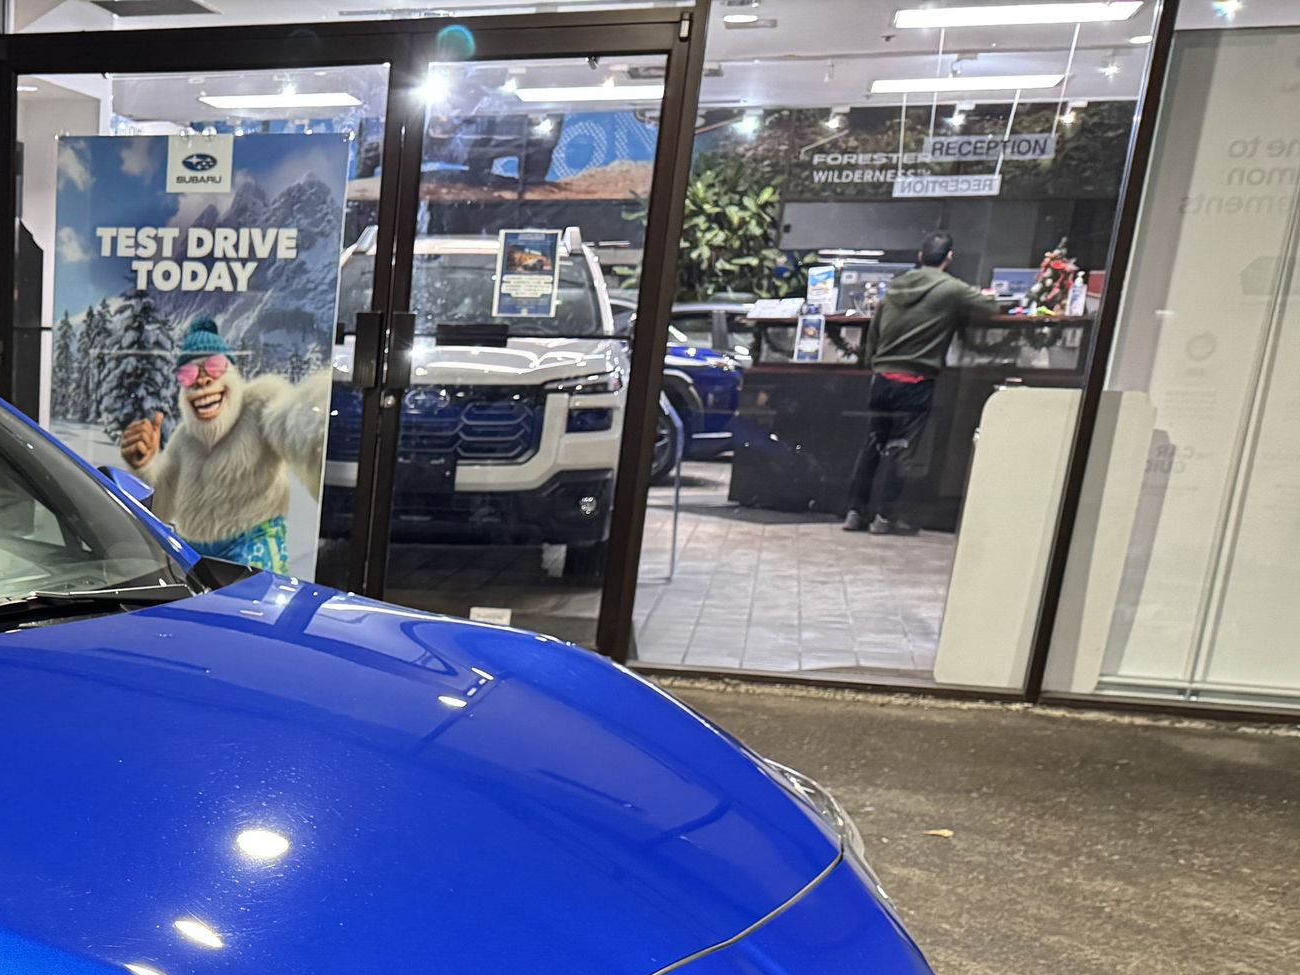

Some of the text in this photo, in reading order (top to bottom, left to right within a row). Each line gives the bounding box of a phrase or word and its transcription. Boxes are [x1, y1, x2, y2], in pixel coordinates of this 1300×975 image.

[931, 139, 1048, 156] RECEPTION
[812, 153, 932, 165] FORESTER
[176, 175, 222, 184] SUBARU
[95, 226, 298, 259] TEST DRIVE
[131, 261, 258, 292] TODAY
